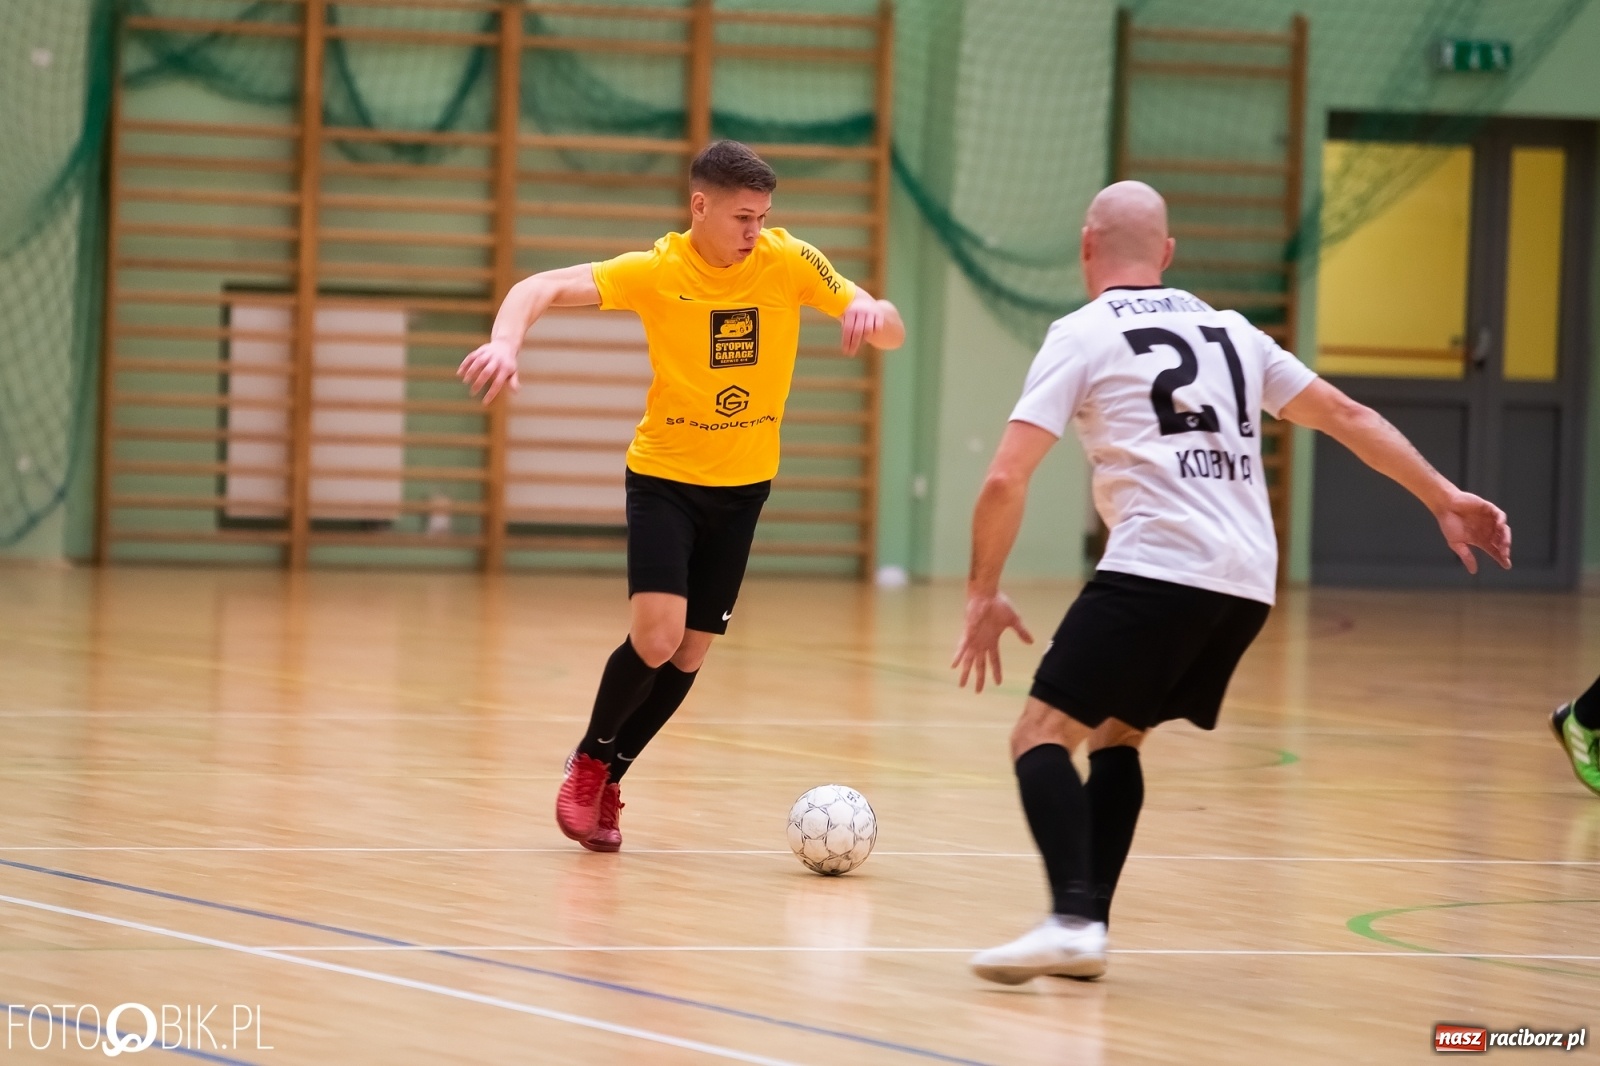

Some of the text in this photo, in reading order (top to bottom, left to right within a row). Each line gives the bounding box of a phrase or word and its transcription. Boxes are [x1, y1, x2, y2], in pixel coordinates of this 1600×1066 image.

[800, 245, 841, 295] WINDAR
[715, 341, 754, 351] STOPIW
[715, 350, 754, 360] GARAGE
[1122, 325, 1255, 437] 21
[665, 417, 685, 425] SG
